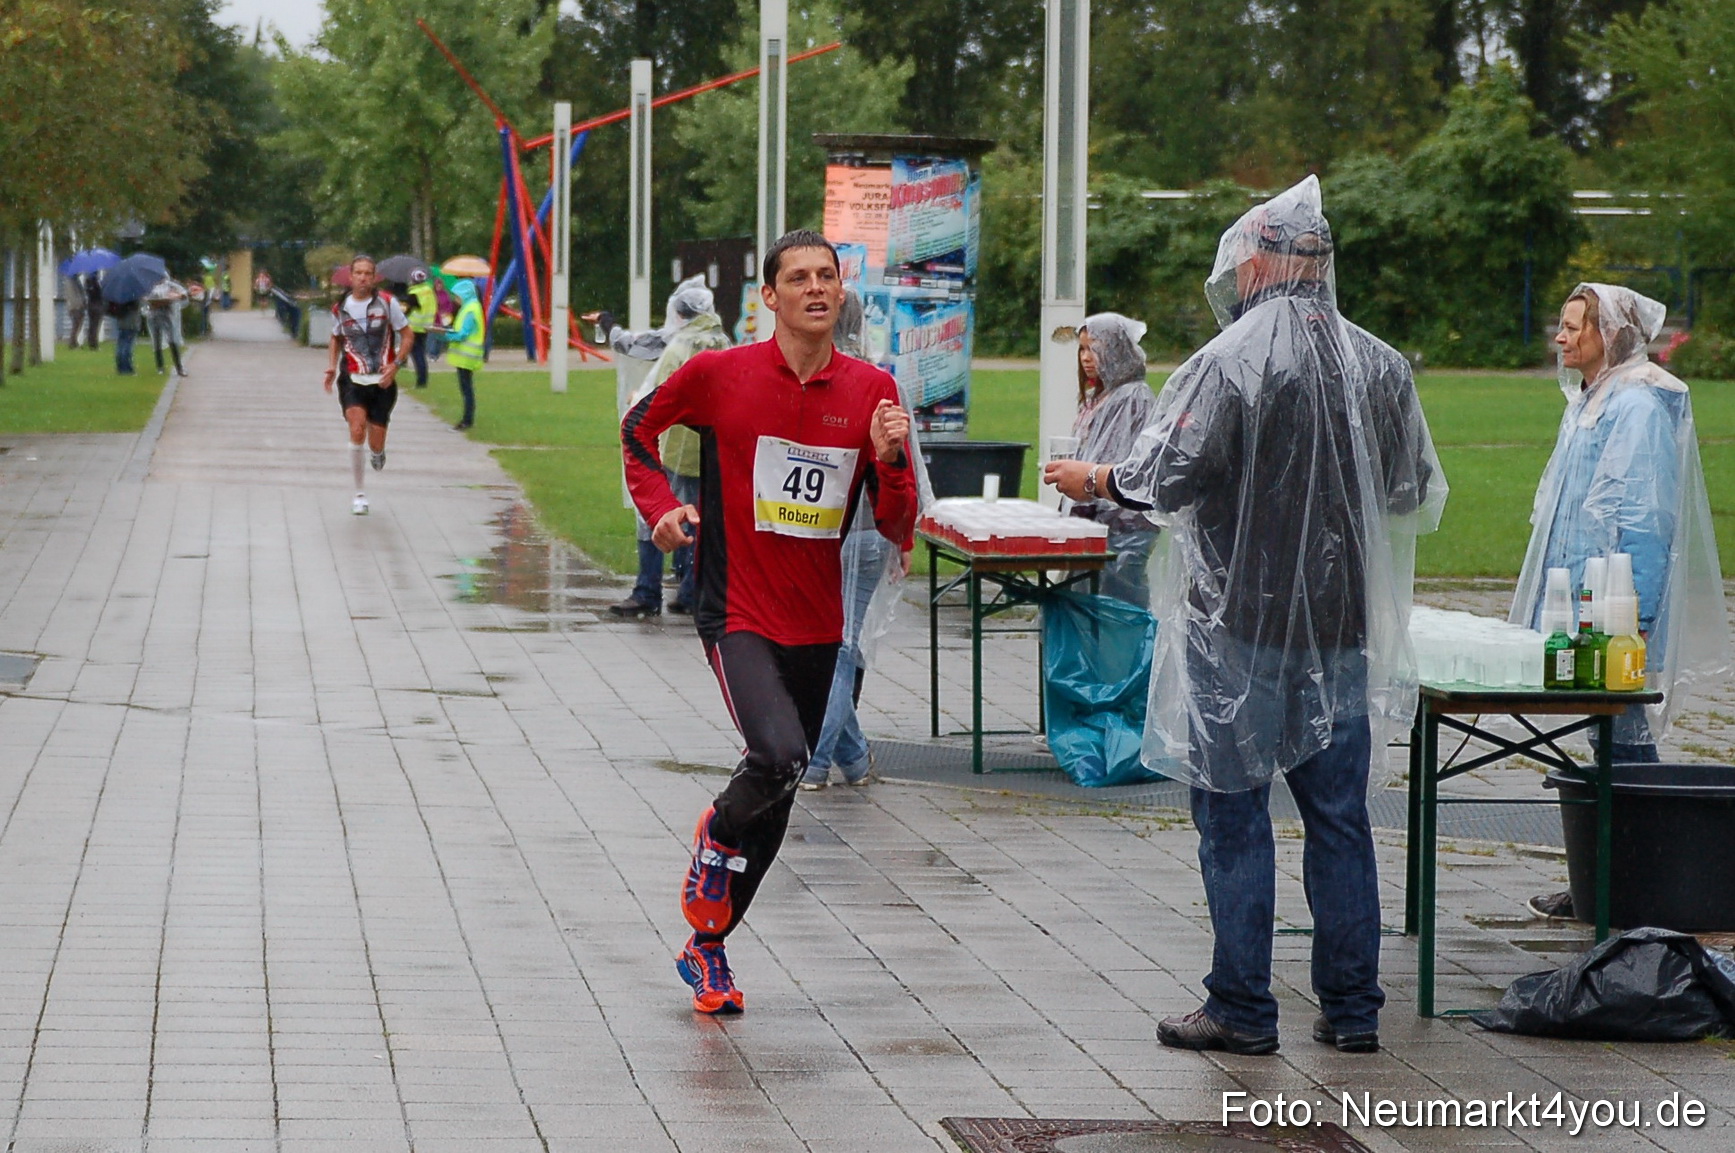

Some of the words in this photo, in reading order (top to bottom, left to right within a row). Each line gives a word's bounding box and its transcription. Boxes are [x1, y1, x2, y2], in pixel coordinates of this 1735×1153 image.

[822, 415, 849, 425] GORE
[782, 466, 825, 504] 49
[778, 507, 820, 525] Robert
